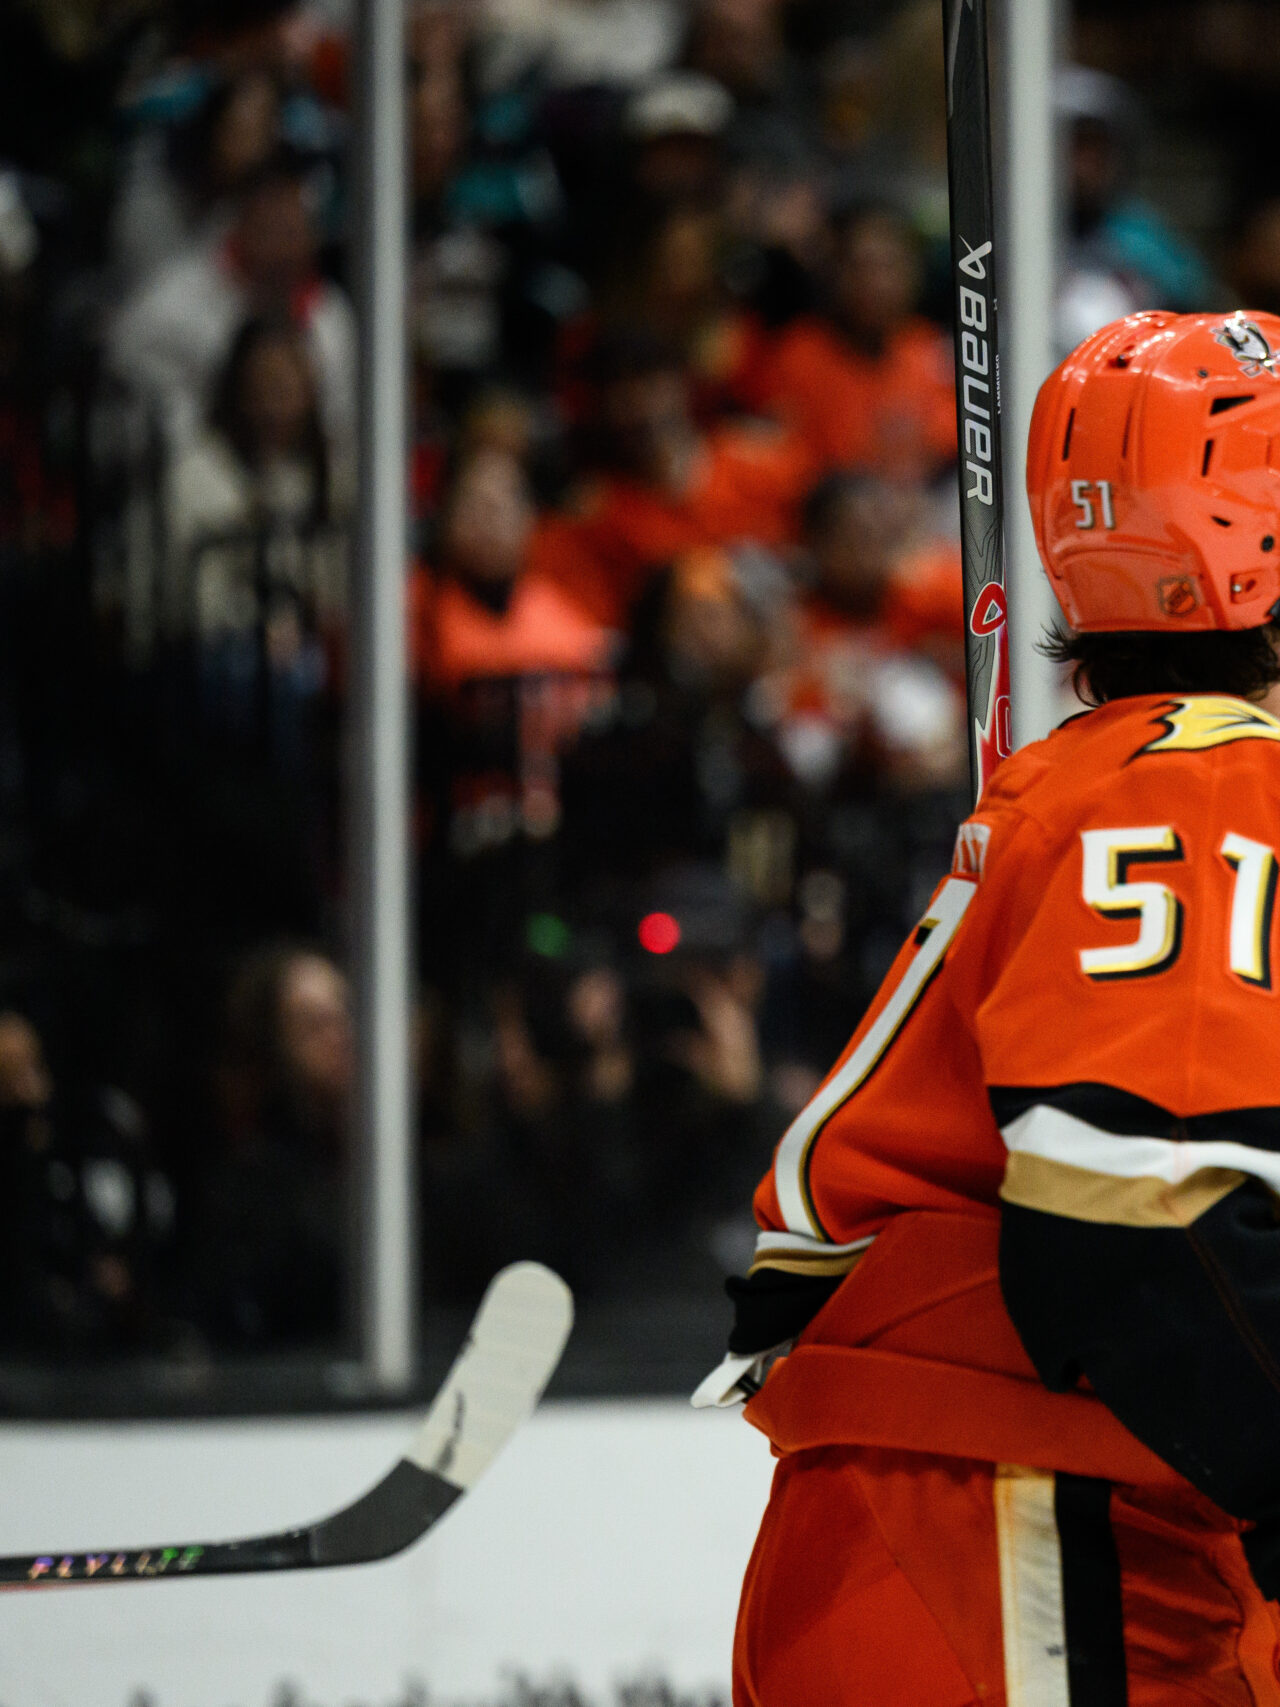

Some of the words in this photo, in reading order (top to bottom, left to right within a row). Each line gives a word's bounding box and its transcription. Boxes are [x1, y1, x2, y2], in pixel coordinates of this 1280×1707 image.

[959, 285, 994, 506] BAUER
[1070, 480, 1115, 530] 51
[1079, 823, 1280, 994] 51
